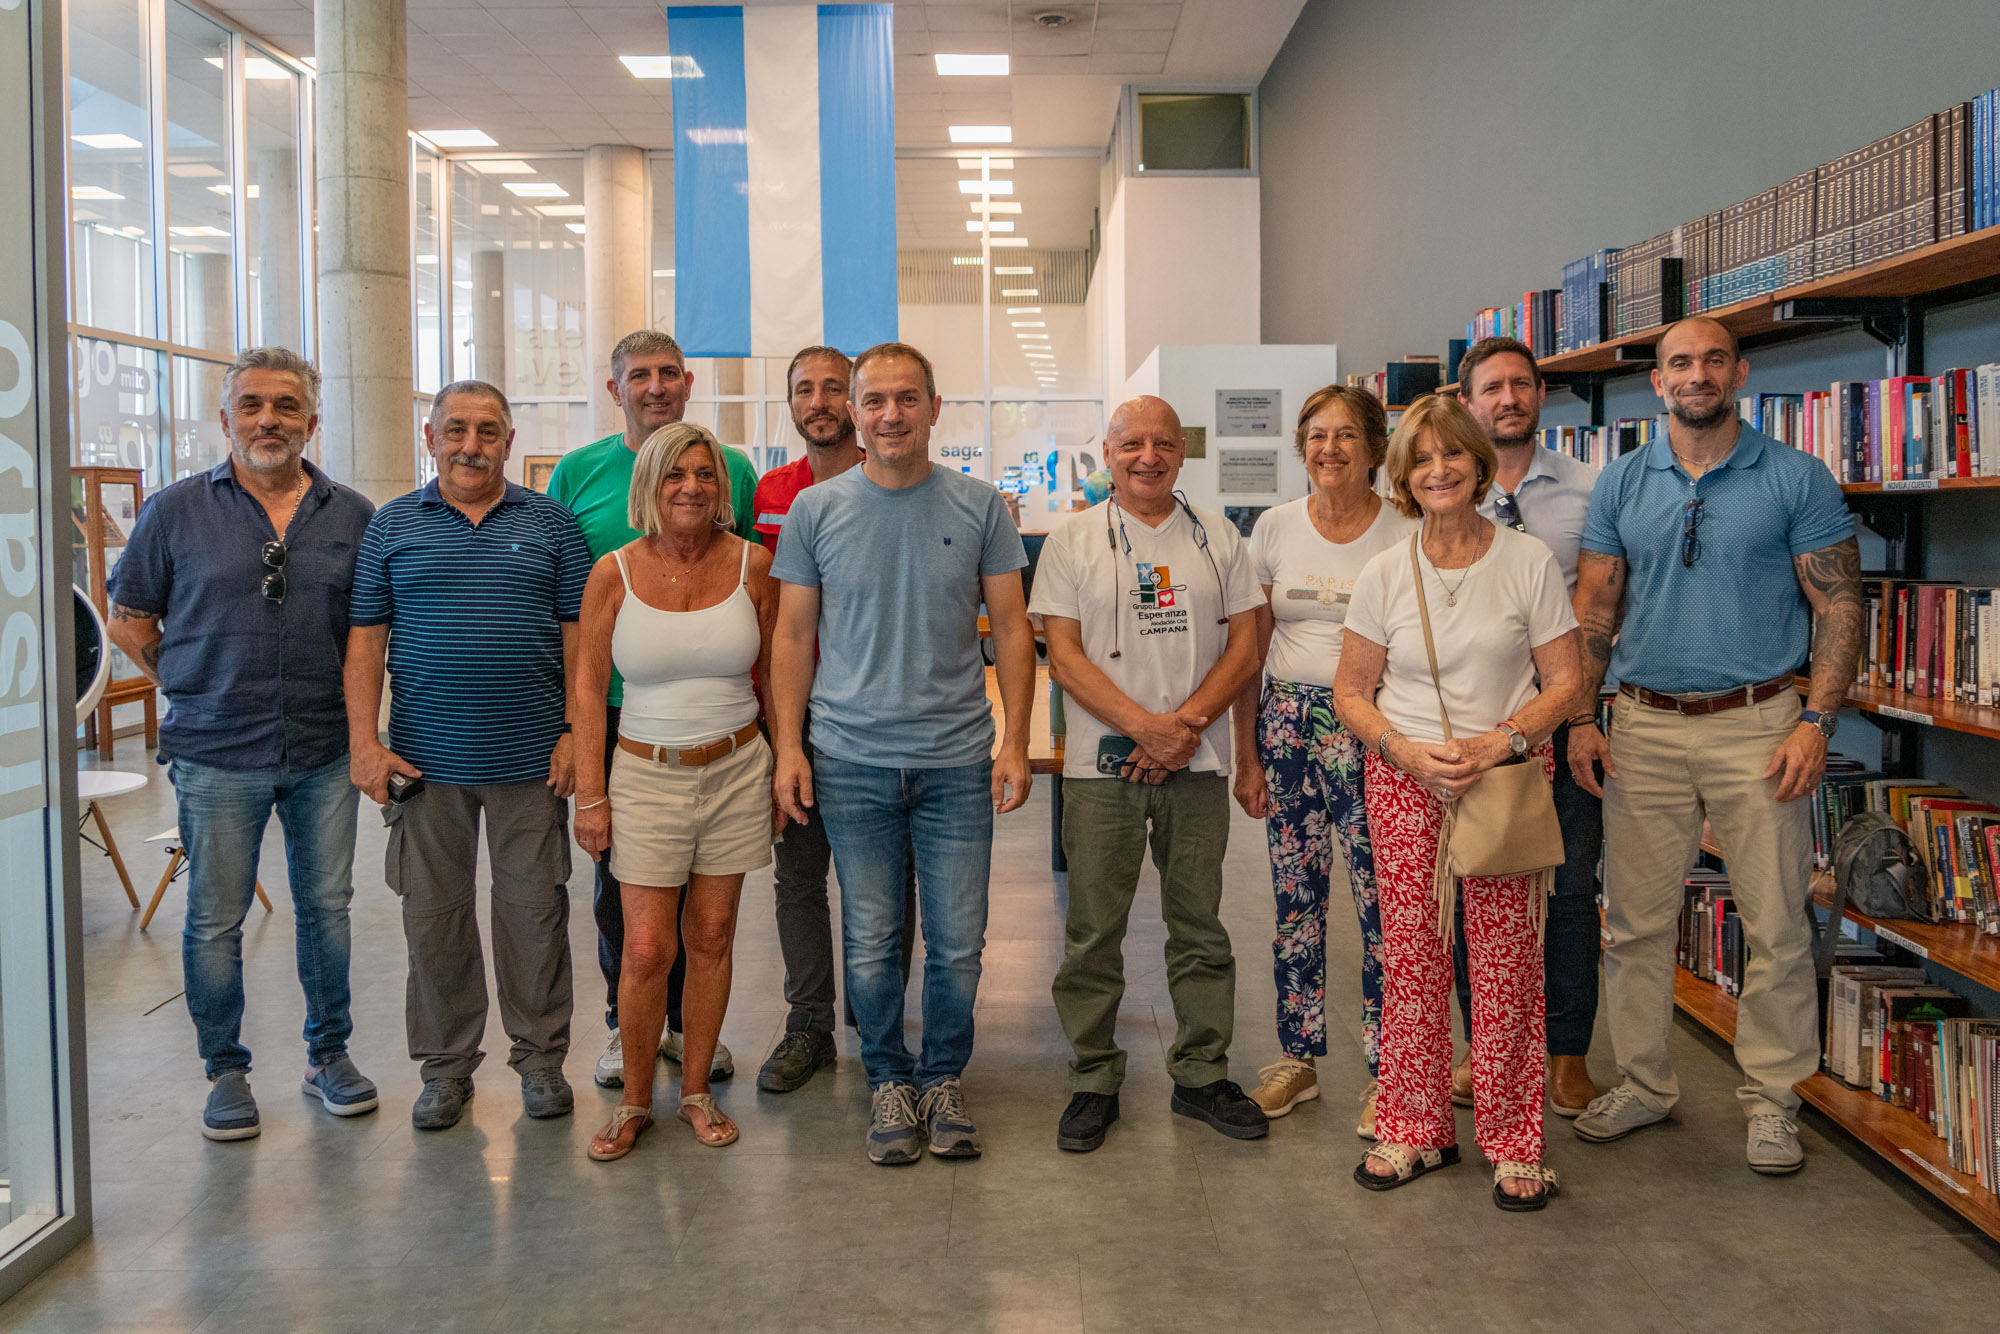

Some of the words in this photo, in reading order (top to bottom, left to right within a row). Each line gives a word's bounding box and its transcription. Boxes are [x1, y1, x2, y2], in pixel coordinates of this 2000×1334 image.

[1827, 182, 1835, 229] Britannica
[941, 446, 982, 460] saga
[1305, 574, 1356, 590] PARIS
[1138, 610, 1187, 620] Esperanza
[1140, 626, 1187, 635] CAMPANA
[1884, 707, 1901, 716] NOVELA
[1907, 712, 1926, 722] CUENTO
[1880, 929, 1898, 941] NOVELA
[1902, 940, 1922, 954] CUENTO
